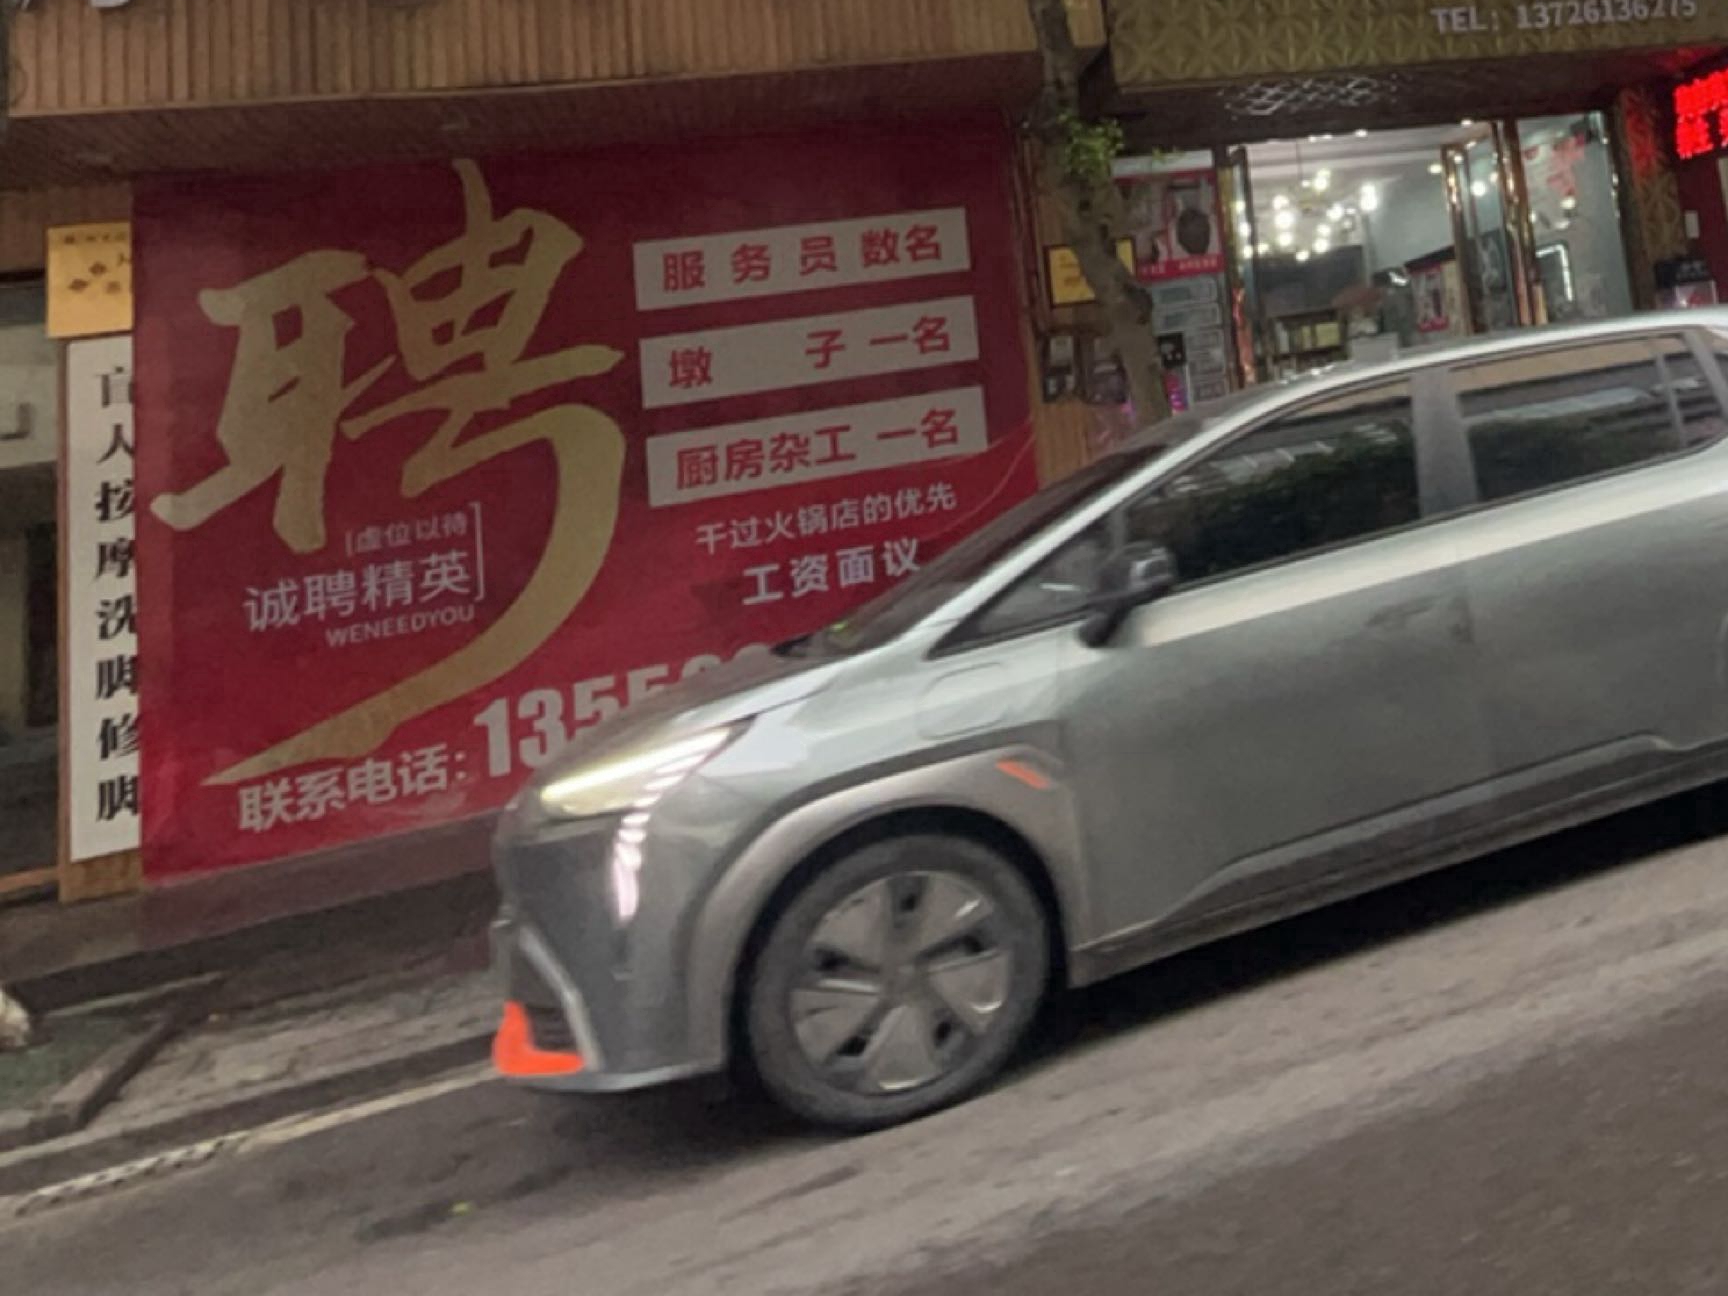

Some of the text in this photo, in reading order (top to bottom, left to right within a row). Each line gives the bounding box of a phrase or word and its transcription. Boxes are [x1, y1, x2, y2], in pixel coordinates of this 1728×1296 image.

[1431, 6, 1499, 35] TEL:
[662, 224, 943, 292] 服务员数名
[150, 157, 626, 786] 聘
[676, 407, 960, 491] 厨房杂工一名
[243, 548, 472, 633] 诚聘精英
[743, 537, 921, 605] 工资面议
[237, 742, 468, 833] 联系电话:
